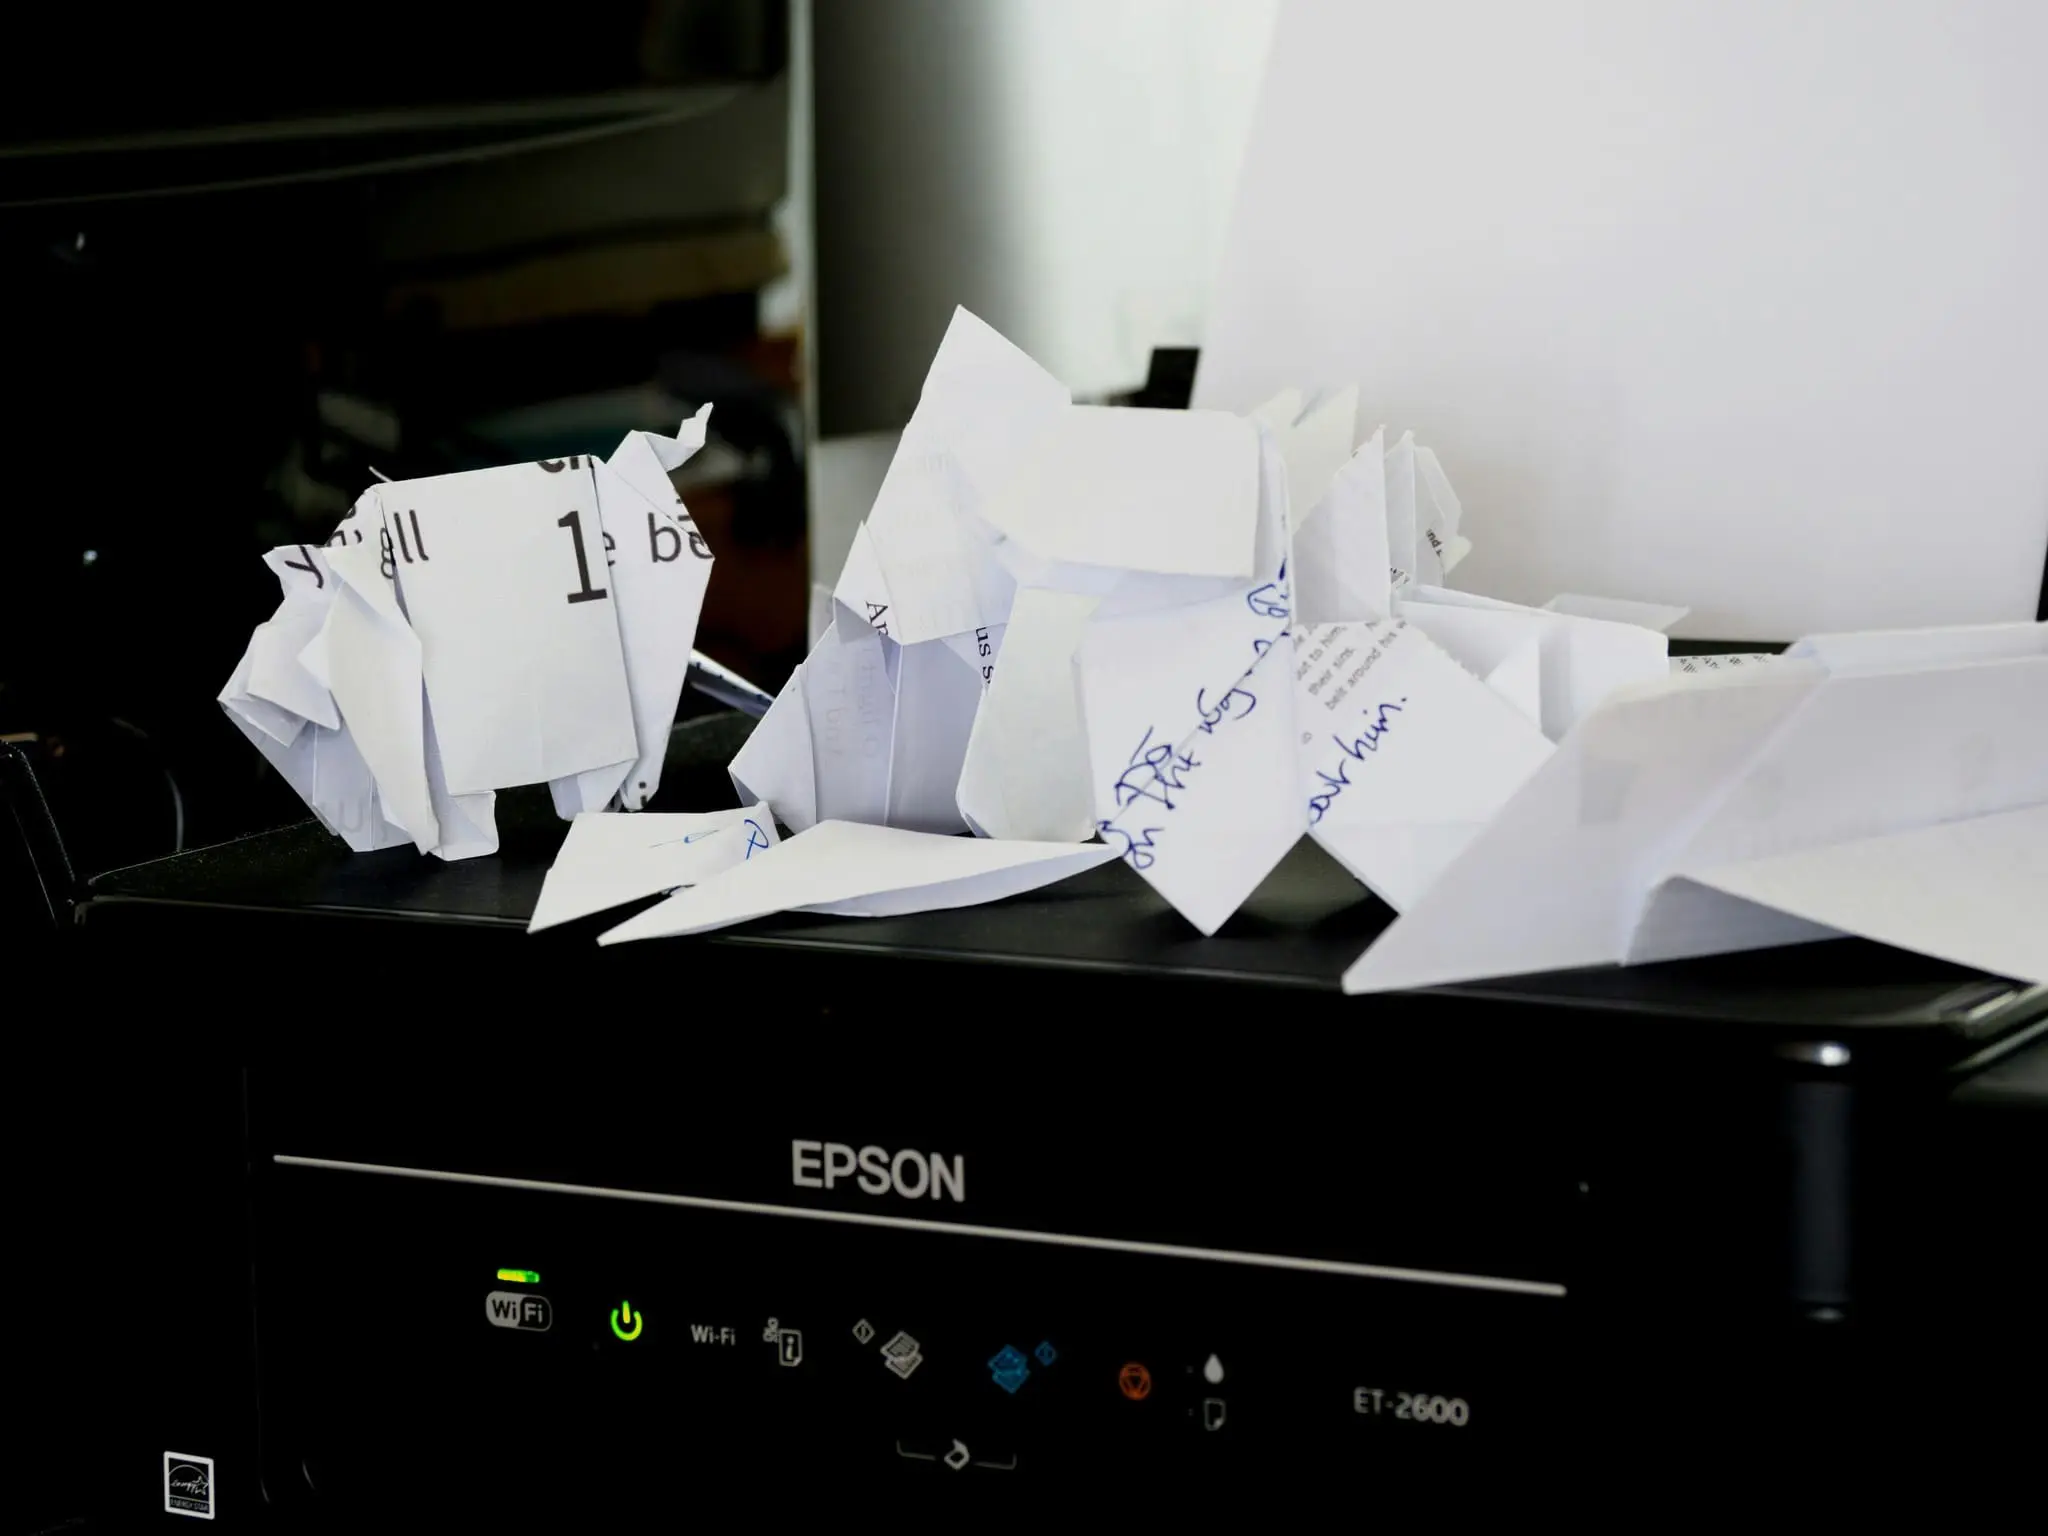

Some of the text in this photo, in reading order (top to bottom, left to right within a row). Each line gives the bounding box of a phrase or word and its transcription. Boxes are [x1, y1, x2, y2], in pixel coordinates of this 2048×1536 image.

[557, 510, 609, 605] 1
[791, 1138, 967, 1204] EPSON
[690, 1324, 737, 1346] Wi-Fi
[1353, 1385, 1471, 1427] ET-2600
